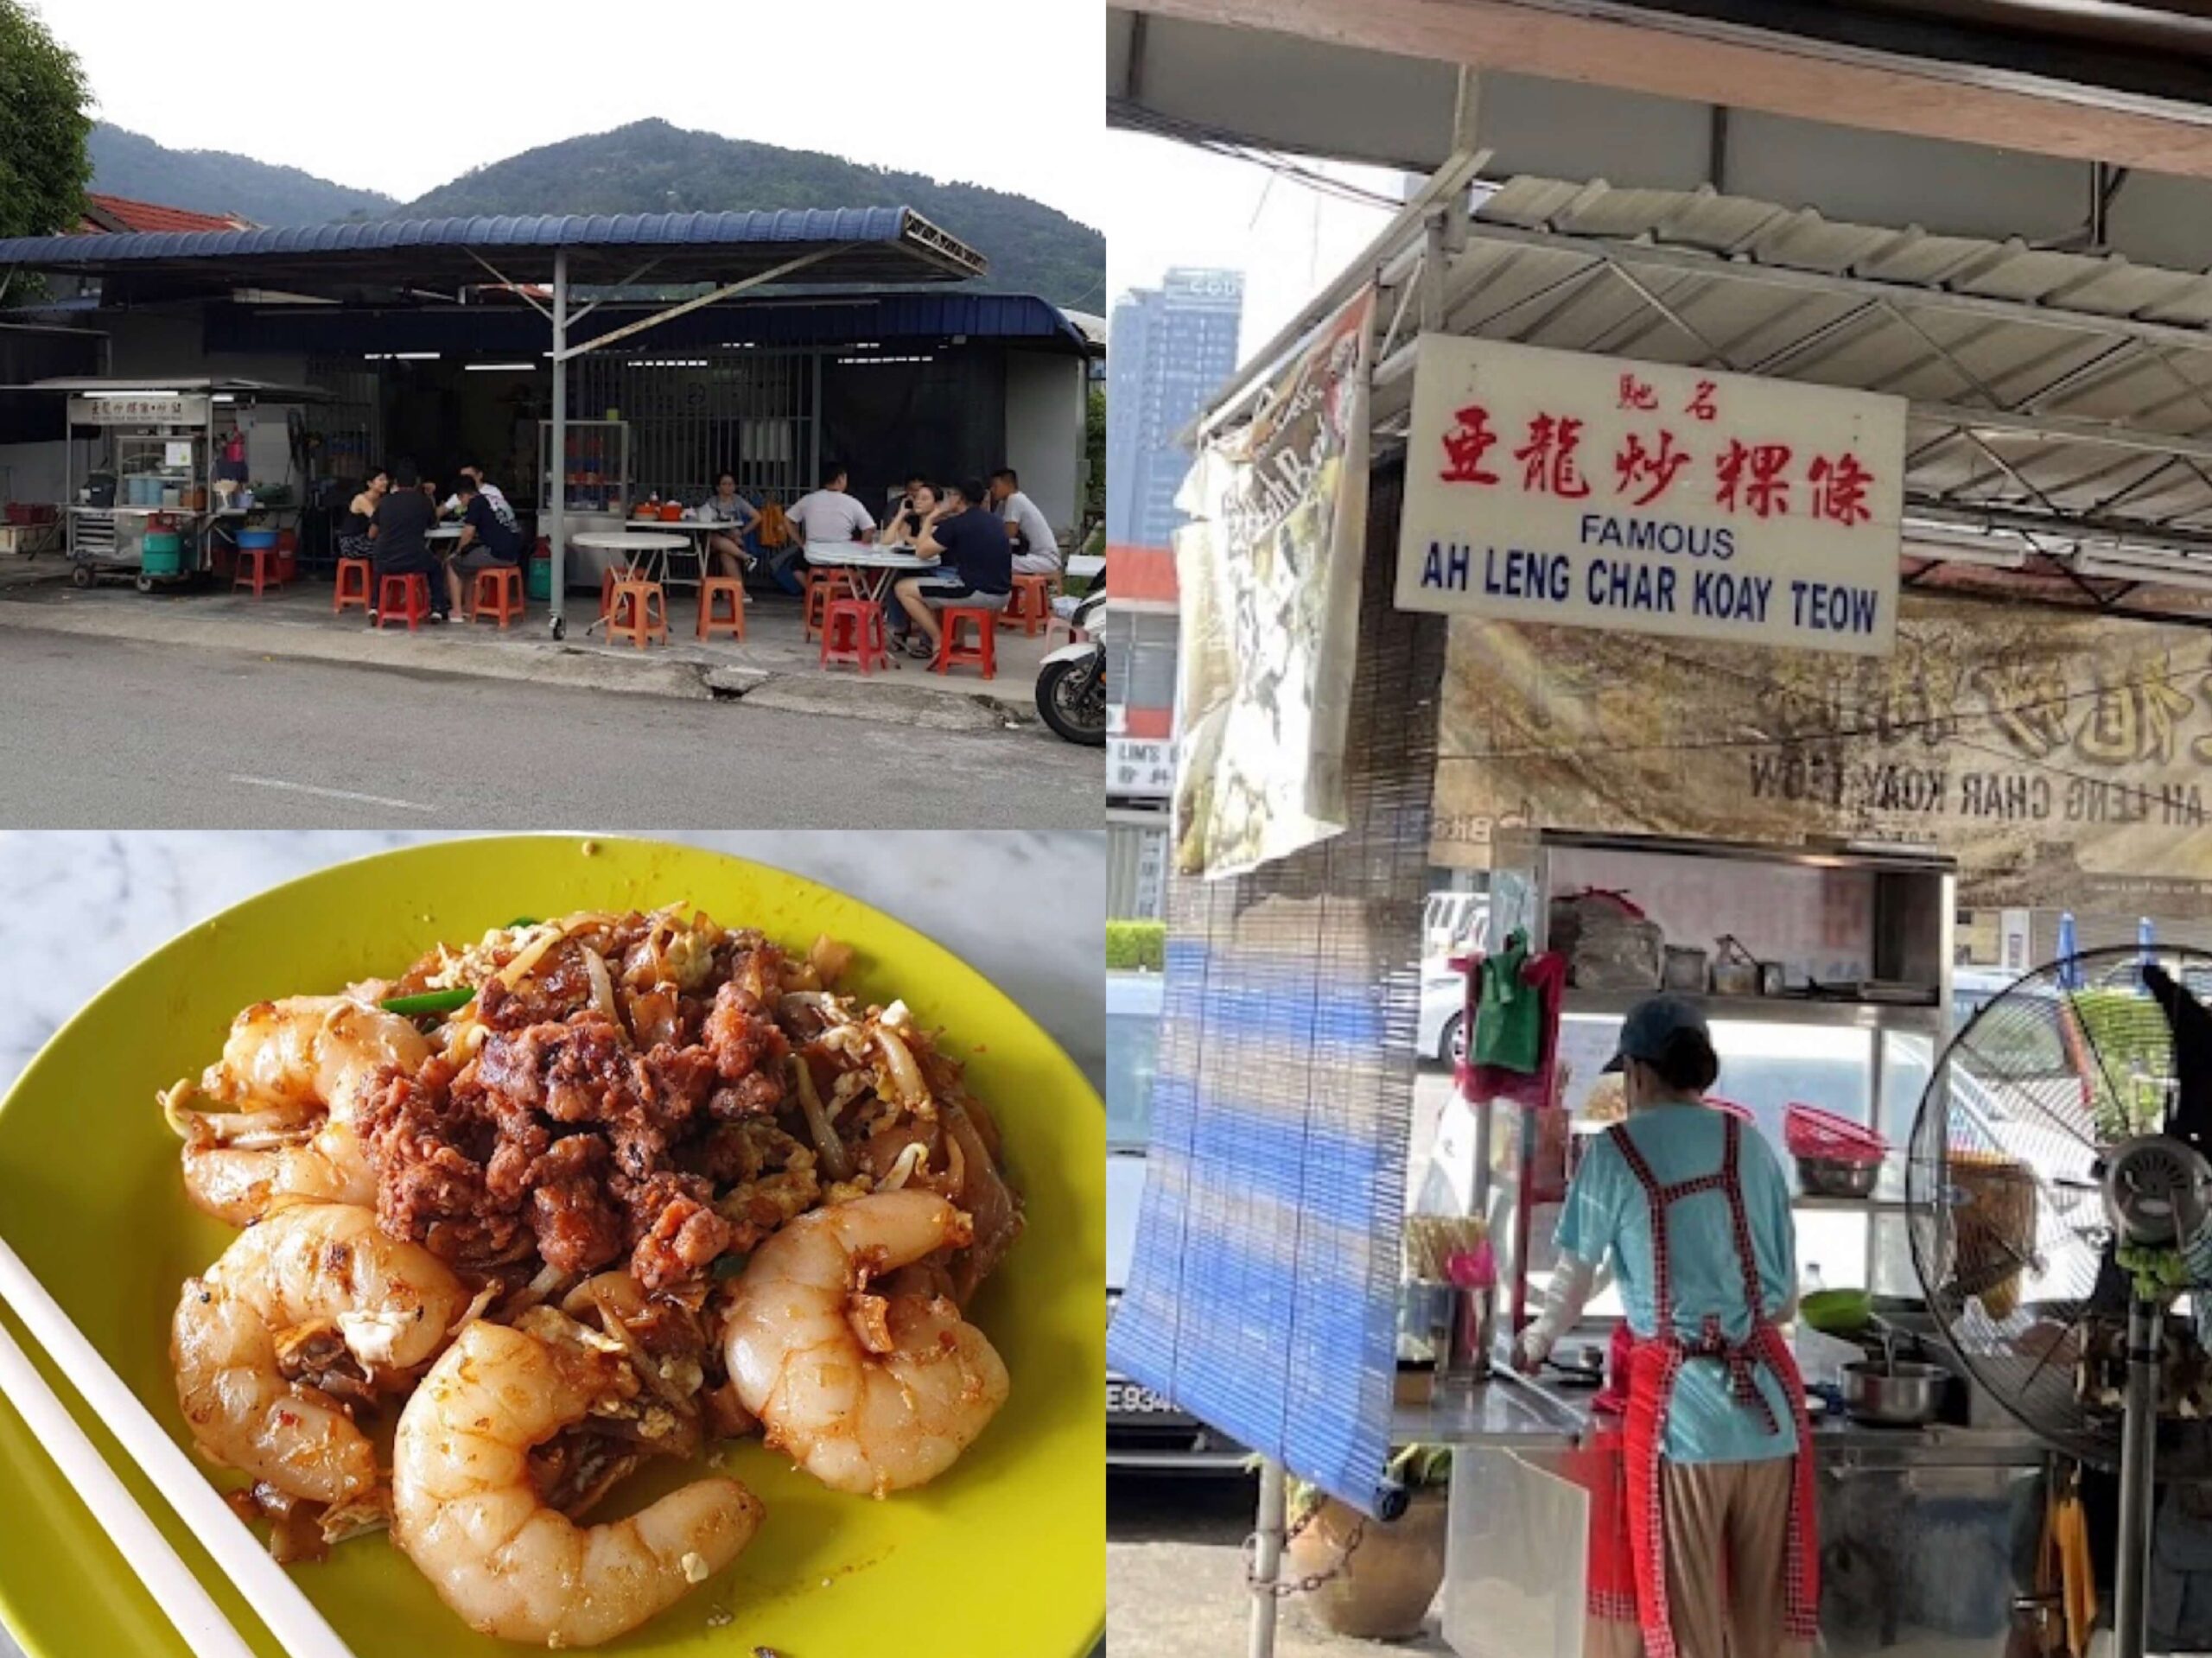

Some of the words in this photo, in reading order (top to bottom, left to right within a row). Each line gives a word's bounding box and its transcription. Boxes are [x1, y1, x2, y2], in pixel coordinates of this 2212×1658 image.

[1580, 515, 1734, 559] FAMOUS
[1421, 543, 1469, 592] AH
[1484, 548, 1570, 602] LENG
[1587, 560, 1675, 613] CHAR
[1692, 572, 1772, 623] KOAY
[1791, 581, 1878, 633] TEOW
